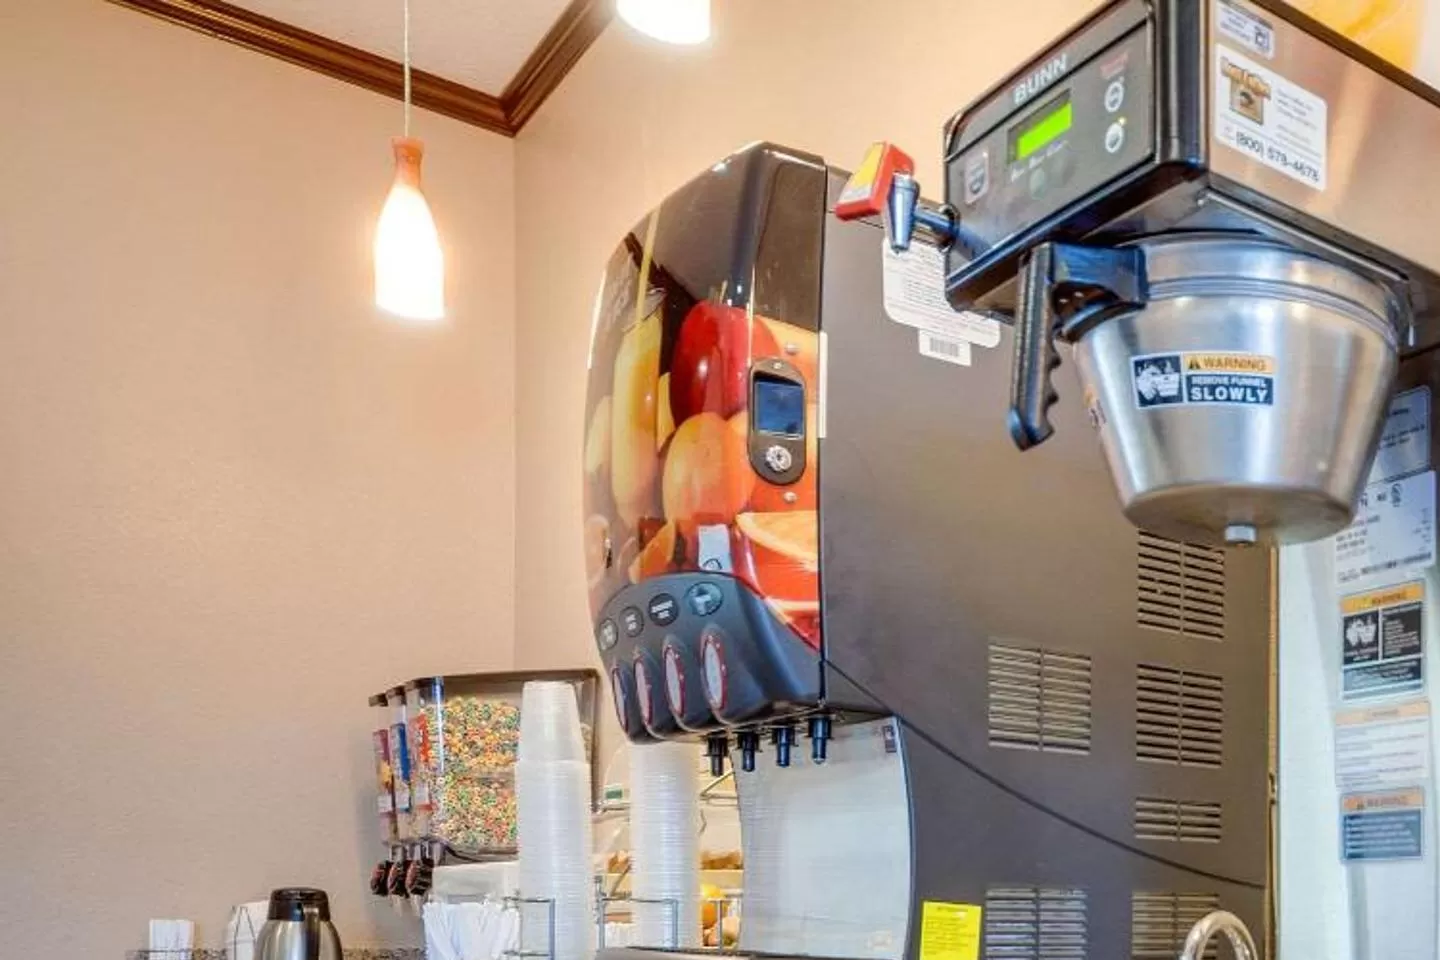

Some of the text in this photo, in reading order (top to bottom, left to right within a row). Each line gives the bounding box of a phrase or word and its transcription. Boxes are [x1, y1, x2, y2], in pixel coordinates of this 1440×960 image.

[1013, 53, 1068, 104] BUNN
[1203, 357, 1267, 371] WARNING
[1190, 386, 1269, 402] SLOWLY
